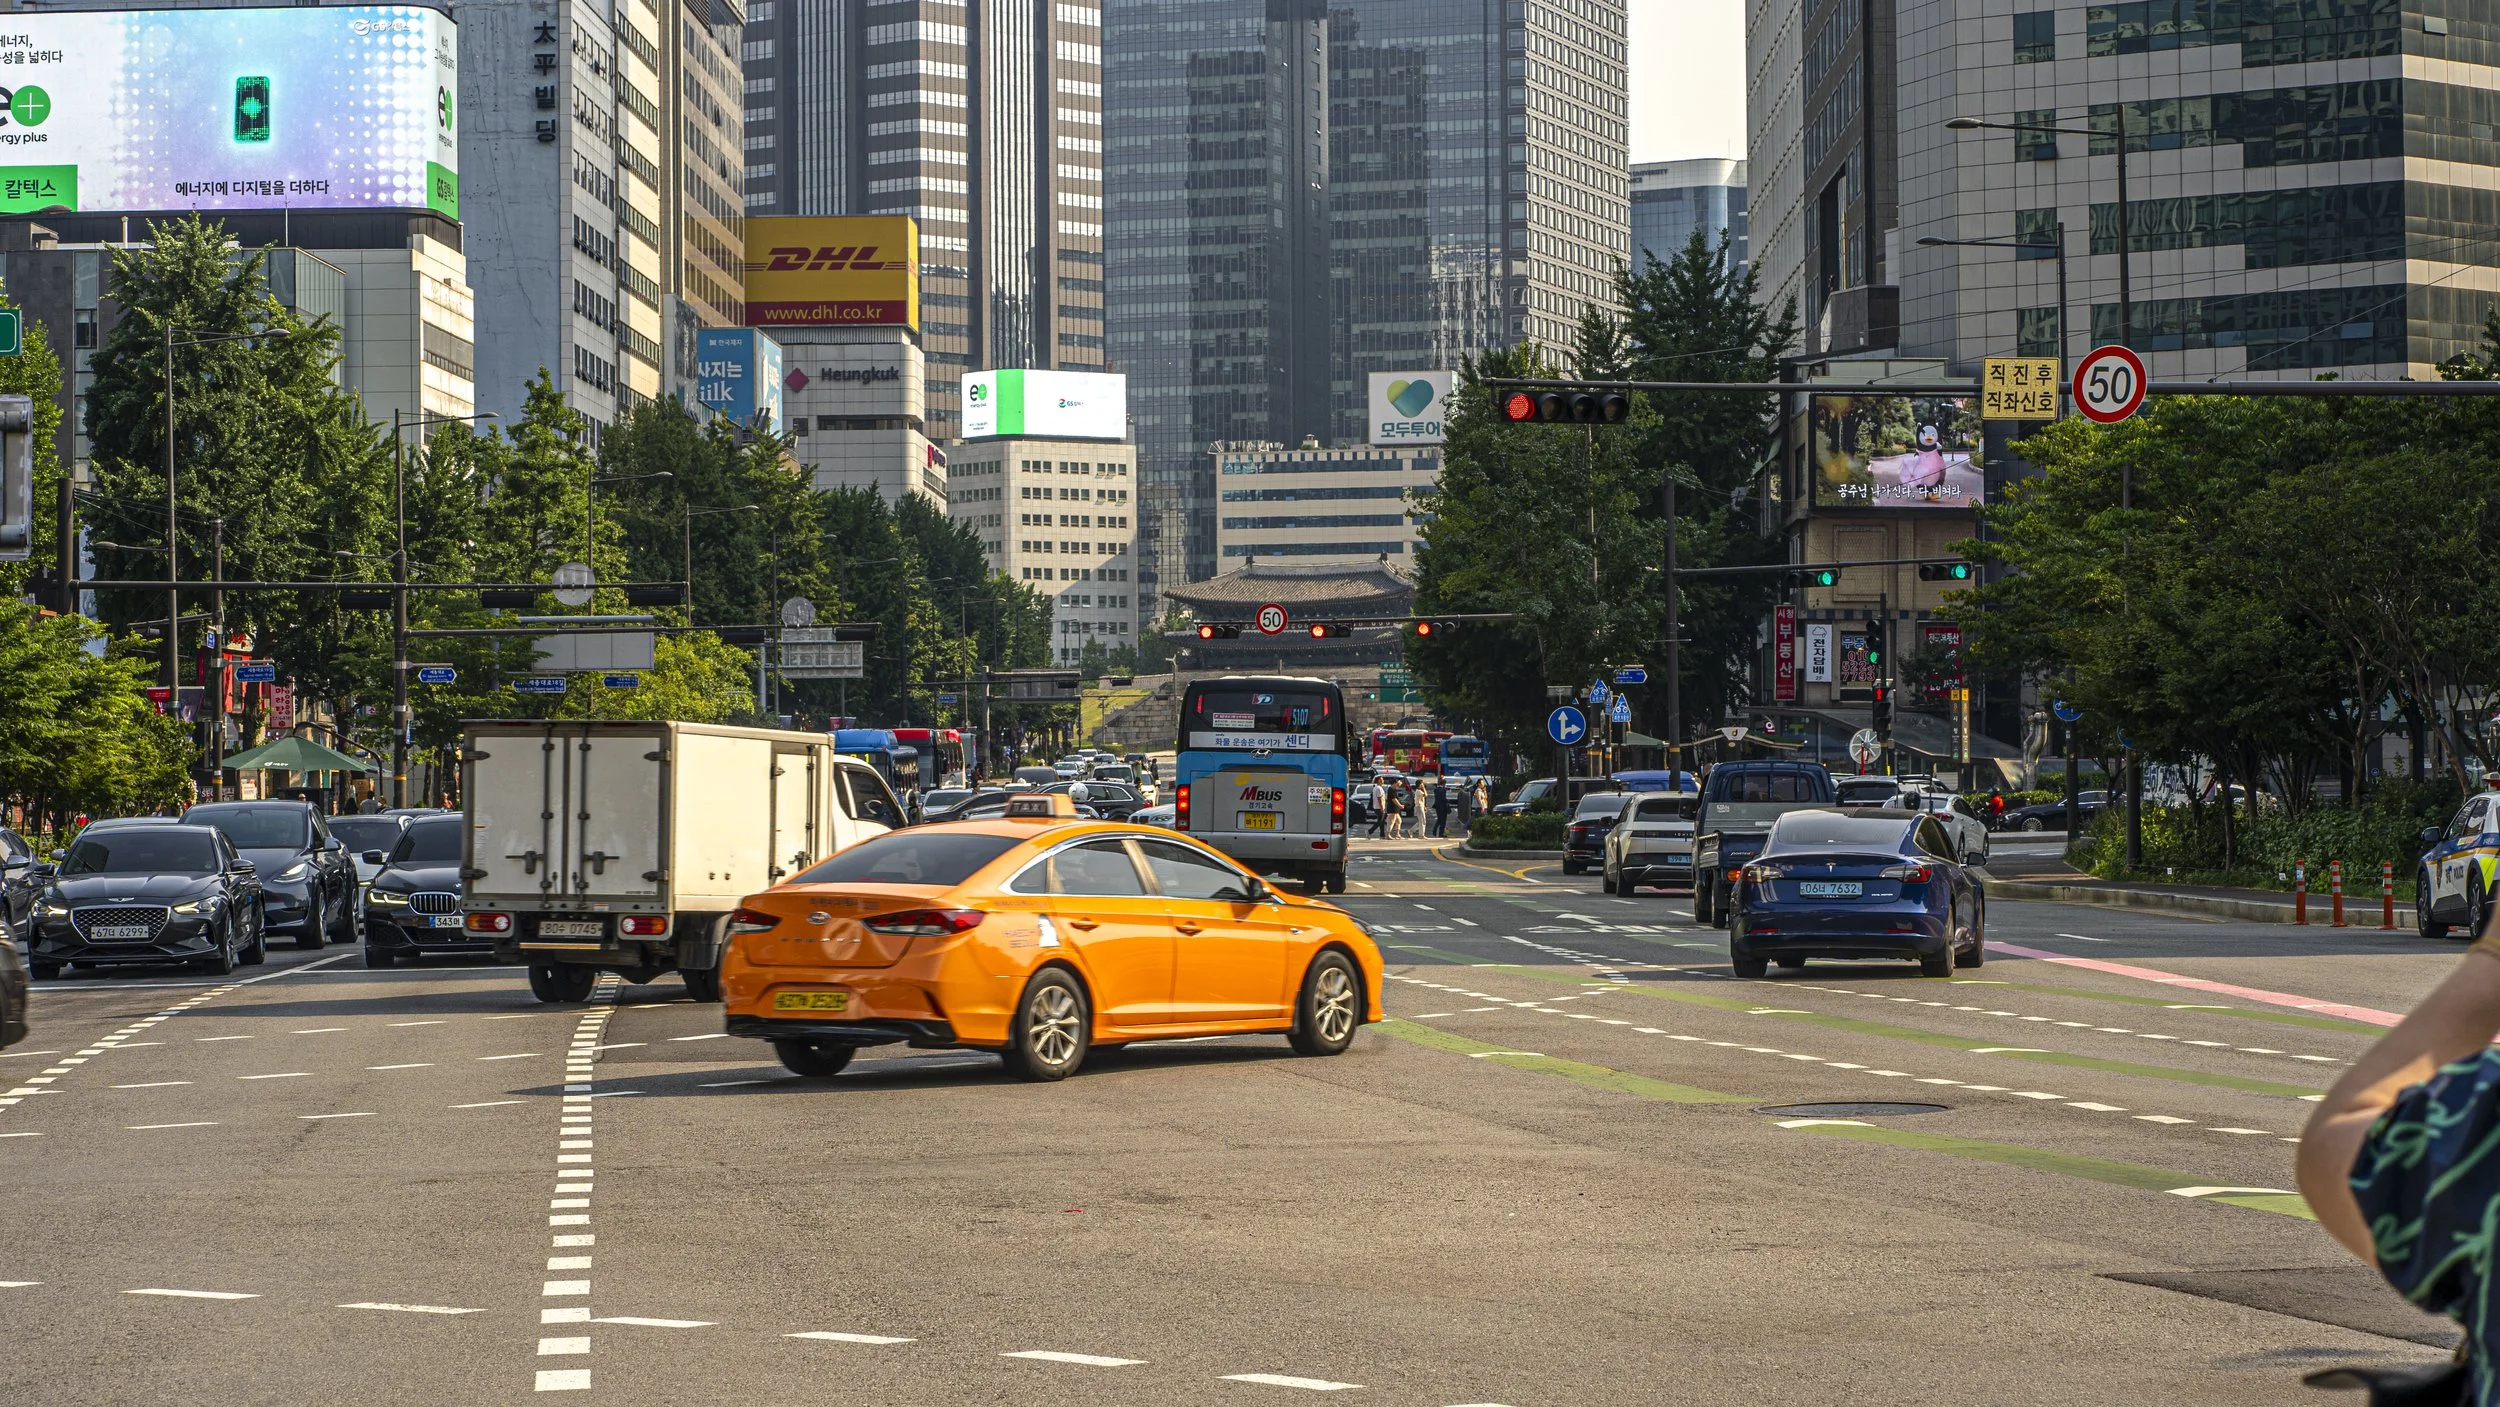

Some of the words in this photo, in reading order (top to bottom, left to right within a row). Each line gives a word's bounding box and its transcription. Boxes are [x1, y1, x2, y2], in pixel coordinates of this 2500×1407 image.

[0, 51, 25, 65] 성을
[29, 50, 63, 64] 넓히다
[0, 135, 21, 144] rgy
[23, 132, 47, 144] plus
[5, 179, 57, 199] 칼텍스
[175, 181, 228, 196] 에너지에
[232, 180, 285, 196] 디지털을
[289, 179, 329, 195] 더하다
[767, 246, 879, 271] DHL
[765, 305, 882, 322] www.dhl.co.kr
[821, 366, 899, 385] Heungkuk
[2088, 366, 2131, 404] 50
[1986, 391, 2054, 413] 직좌신호
[1381, 421, 1440, 438] 모두투어
[1838, 484, 1867, 498] 공주님
[1919, 484, 1928, 498] 다
[1262, 611, 1282, 628] 50
[1778, 608, 1794, 618] 시청
[1841, 635, 1869, 649] 부동
[1779, 623, 1793, 678] 부동산
[1813, 638, 1826, 675] 전자담배
[1841, 671, 1875, 681] 7793
[1215, 737, 1230, 746] 화물
[1233, 738, 1255, 746] 운송은
[1257, 739, 1280, 747] 여기가
[1285, 734, 1310, 748] 센디
[1240, 786, 1283, 801] MBUS
[1013, 803, 1046, 813] TAXI
[1830, 883, 1857, 893] 7632
[119, 927, 143, 937] 6299
[570, 923, 597, 934] 0745
